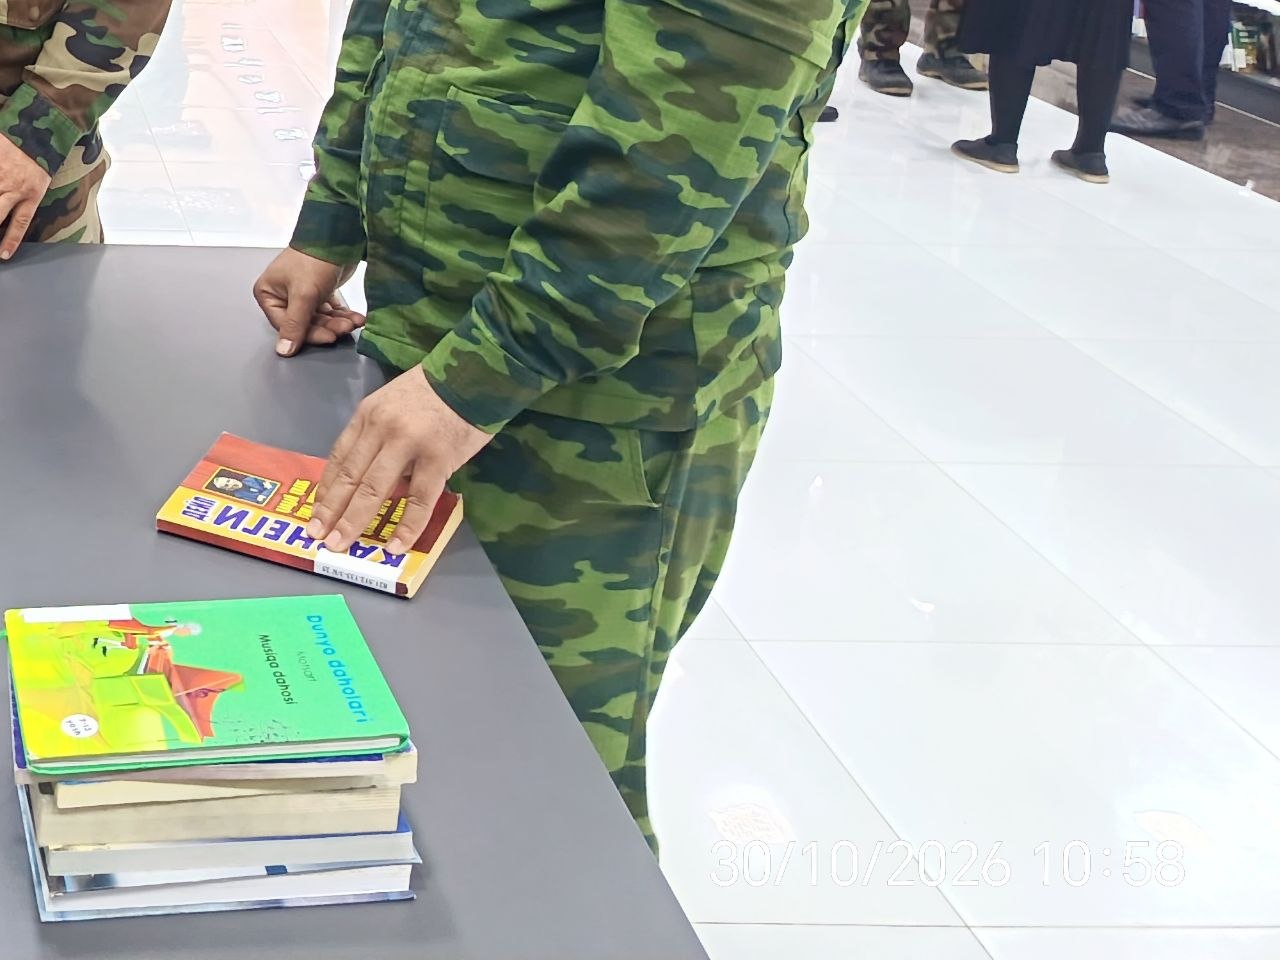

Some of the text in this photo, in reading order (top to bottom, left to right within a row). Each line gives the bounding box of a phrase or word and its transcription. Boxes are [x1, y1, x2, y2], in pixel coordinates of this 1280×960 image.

[212, 504, 407, 568] КАНЕГИ
[257, 633, 298, 705] Musiqa dahosi
[305, 614, 373, 724] Dunyo daholari
